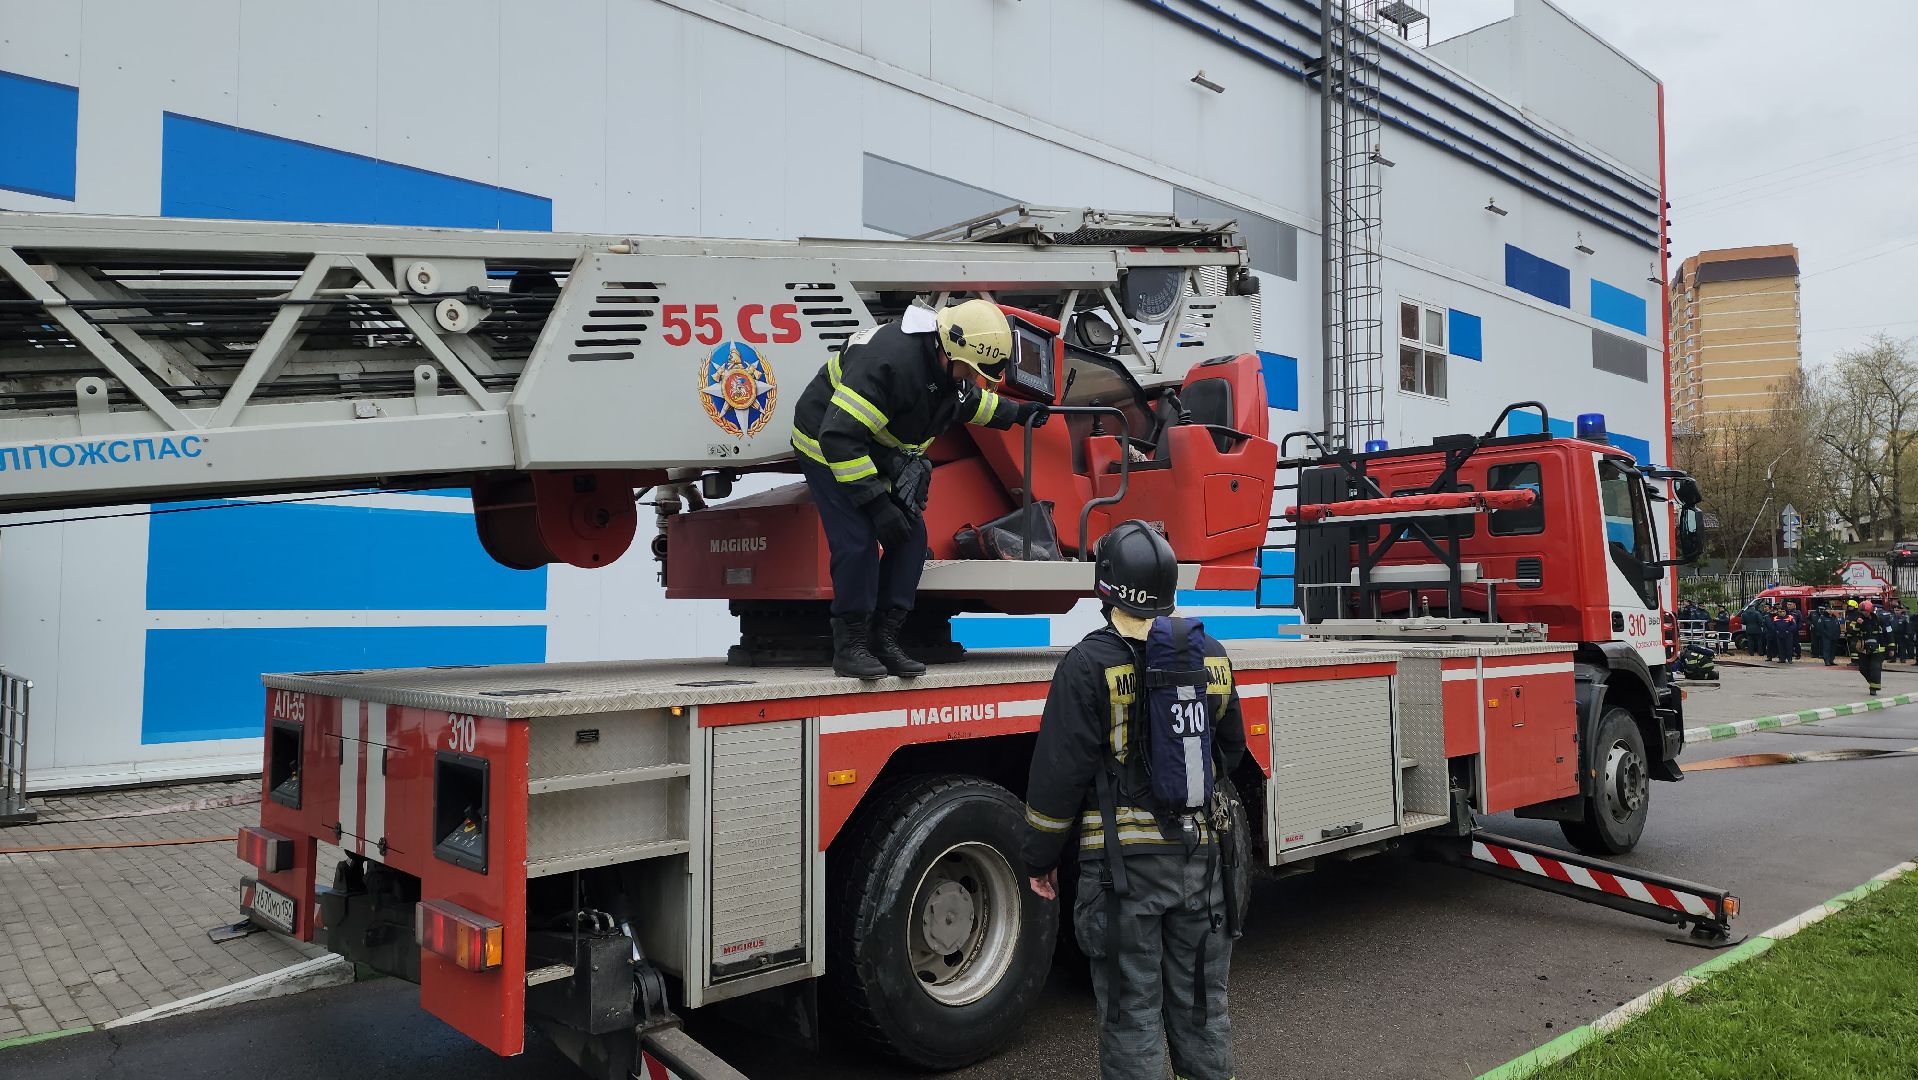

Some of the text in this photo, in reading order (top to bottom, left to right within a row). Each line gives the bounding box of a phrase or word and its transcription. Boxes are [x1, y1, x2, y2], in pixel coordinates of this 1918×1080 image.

[662, 303, 802, 346] 55 CS
[710, 536, 767, 553] MAGIRUS
[1628, 613, 1647, 637] 310
[273, 690, 305, 722] АЛ-55
[910, 703, 996, 726] MAGIRUS
[1170, 701, 1205, 734] 310
[448, 712, 476, 753] 310
[723, 939, 765, 955] MAGIRUS
